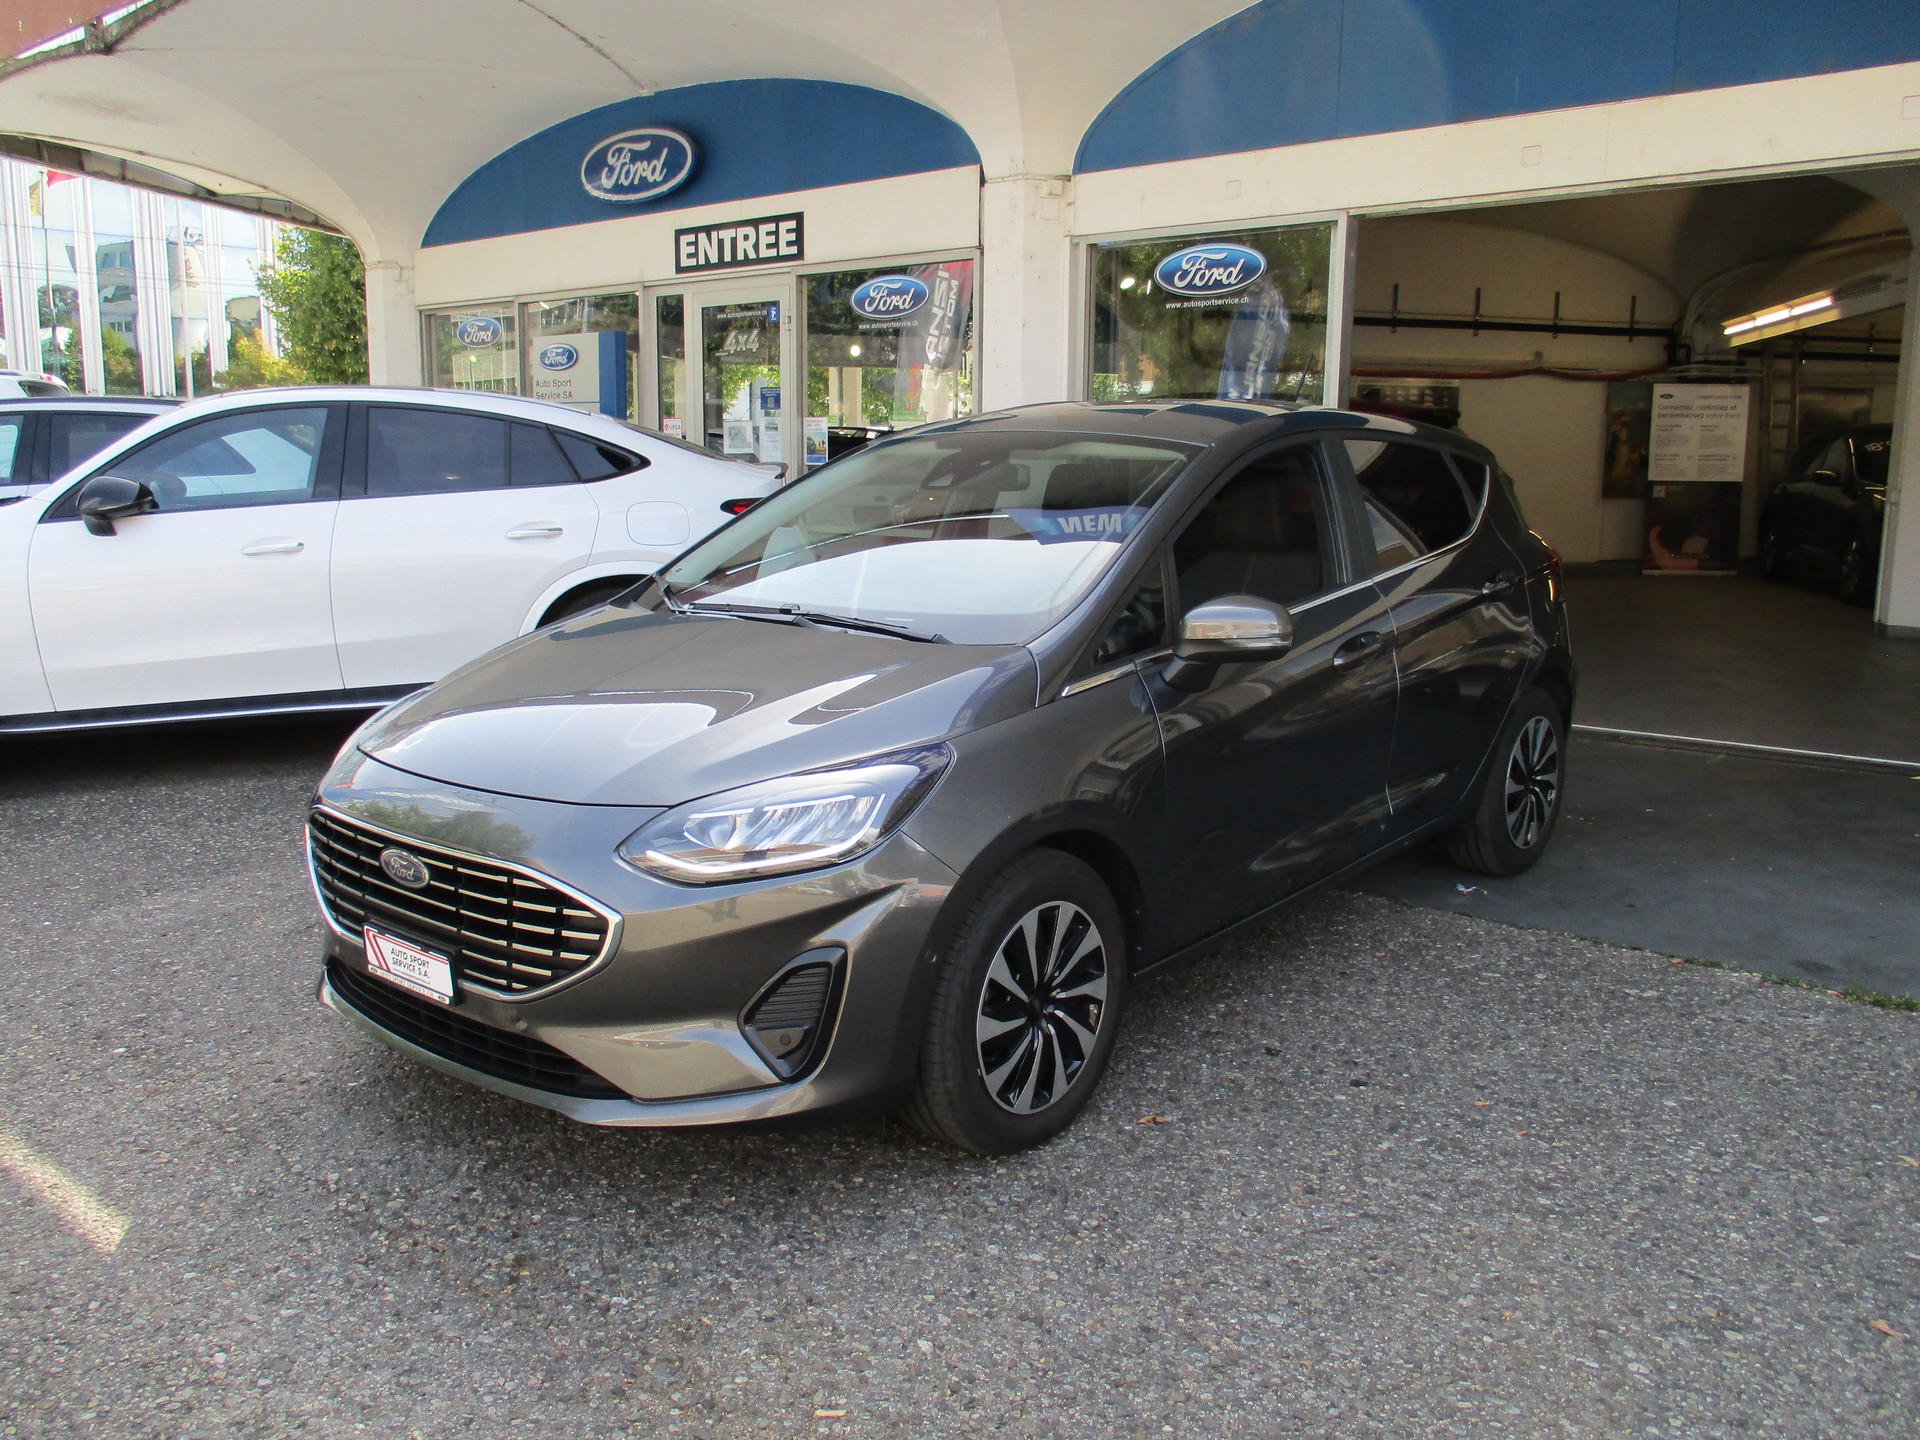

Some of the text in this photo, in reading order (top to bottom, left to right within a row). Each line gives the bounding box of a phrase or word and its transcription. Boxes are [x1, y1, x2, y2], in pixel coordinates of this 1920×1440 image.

[601, 139, 669, 189] Ford
[679, 219, 799, 268] ENTREE
[1173, 251, 1246, 289] Ford
[863, 281, 916, 314] Ford
[1165, 295, 1250, 310] www.autosportservice.ch
[464, 320, 495, 344] Ford
[723, 328, 761, 354] 4x4
[543, 347, 569, 366] Ford
[535, 379, 572, 389] Auto Sport
[535, 391, 573, 400] Service SA
[389, 857, 415, 881] Ford
[390, 947, 430, 970] AUTO SPORT
[391, 957, 416, 974] SERVICE
